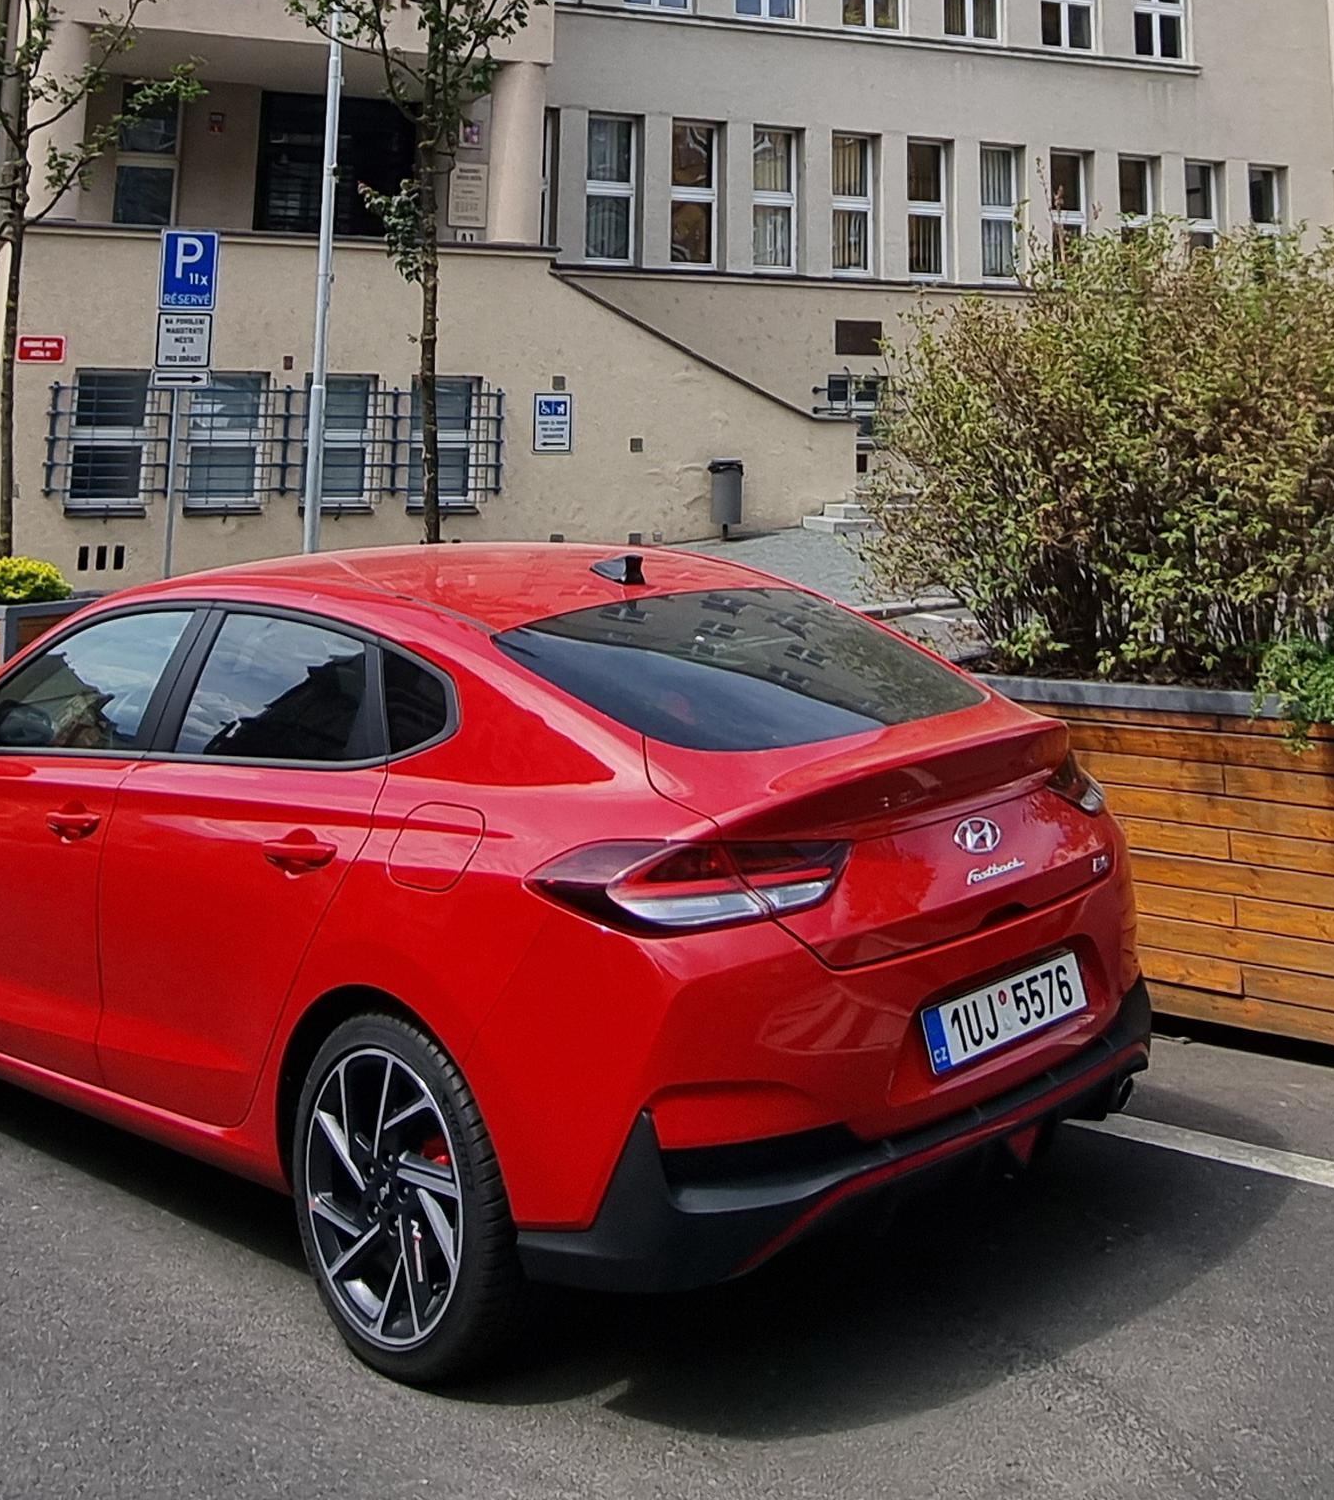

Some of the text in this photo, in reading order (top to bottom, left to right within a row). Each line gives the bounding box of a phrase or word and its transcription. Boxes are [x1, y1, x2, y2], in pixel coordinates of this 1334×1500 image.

[175, 237, 204, 278] P
[967, 857, 1025, 886] Fastback
[933, 965, 1073, 1064] CZ 1UJ 5576
